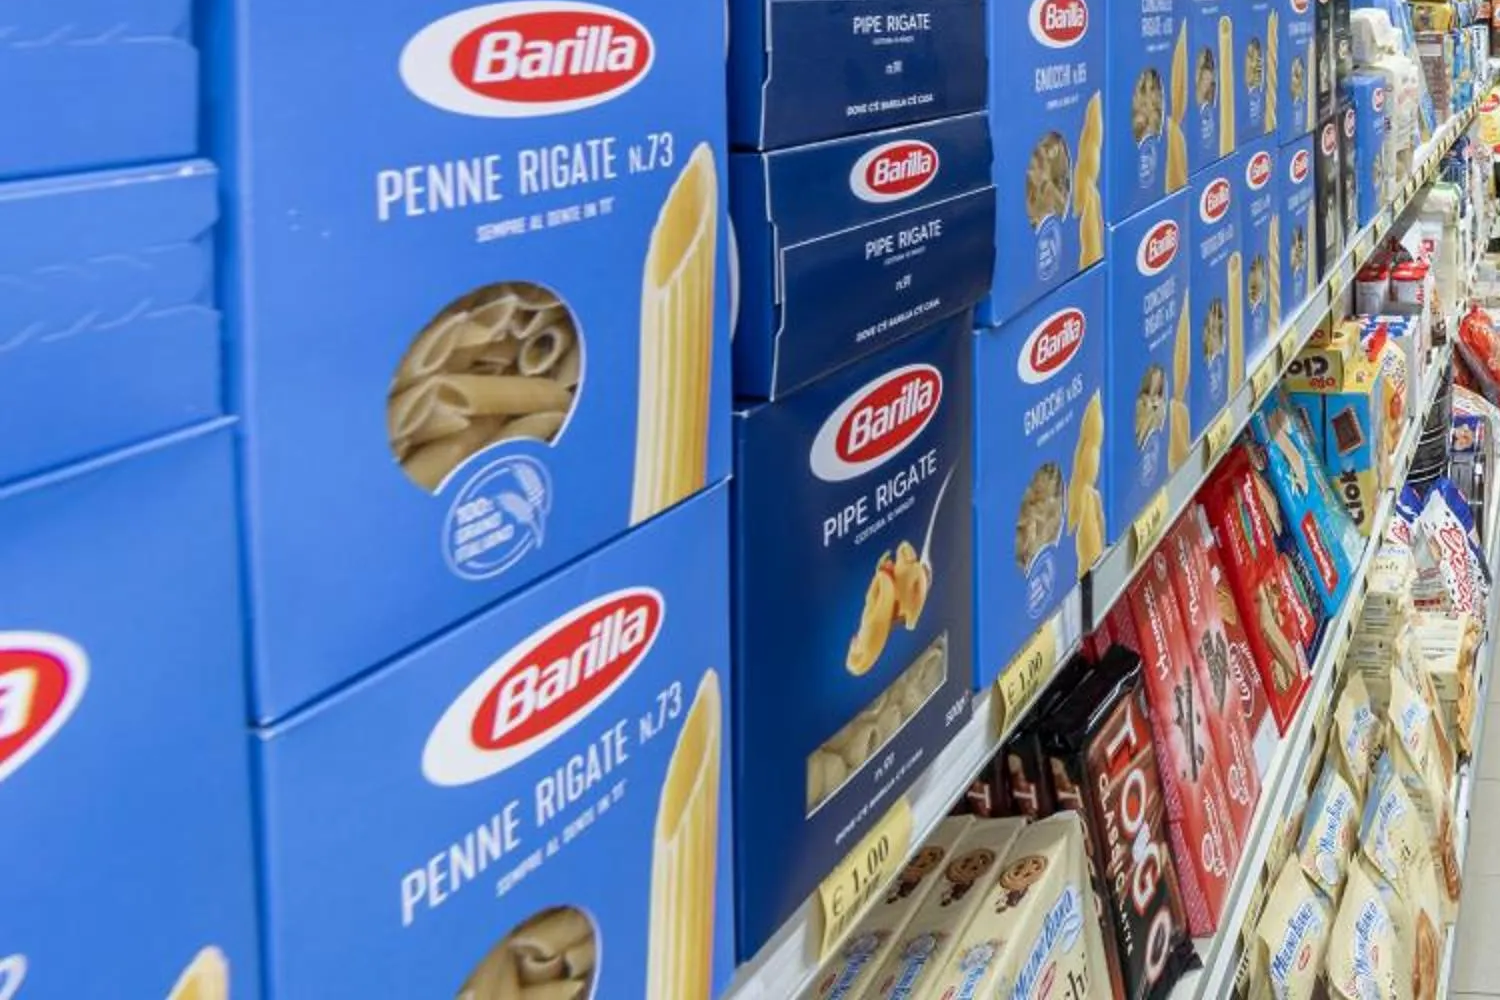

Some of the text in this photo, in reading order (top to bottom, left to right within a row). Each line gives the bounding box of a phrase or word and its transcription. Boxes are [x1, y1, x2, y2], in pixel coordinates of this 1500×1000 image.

[853, 12, 931, 34] PIPE RIGATE
[1045, 2, 1085, 31] Barilla
[471, 25, 639, 84] Barilla
[376, 154, 503, 222] PENNE
[518, 137, 618, 197] RIGATE
[873, 149, 932, 187] Barilla
[865, 219, 944, 260] PIPE RIGATE
[846, 376, 934, 457] Barilla
[823, 449, 938, 547] PIPE RIGATE
[491, 605, 649, 741] Barilla
[401, 800, 522, 927] PENNE
[534, 719, 629, 828] RIGATE
